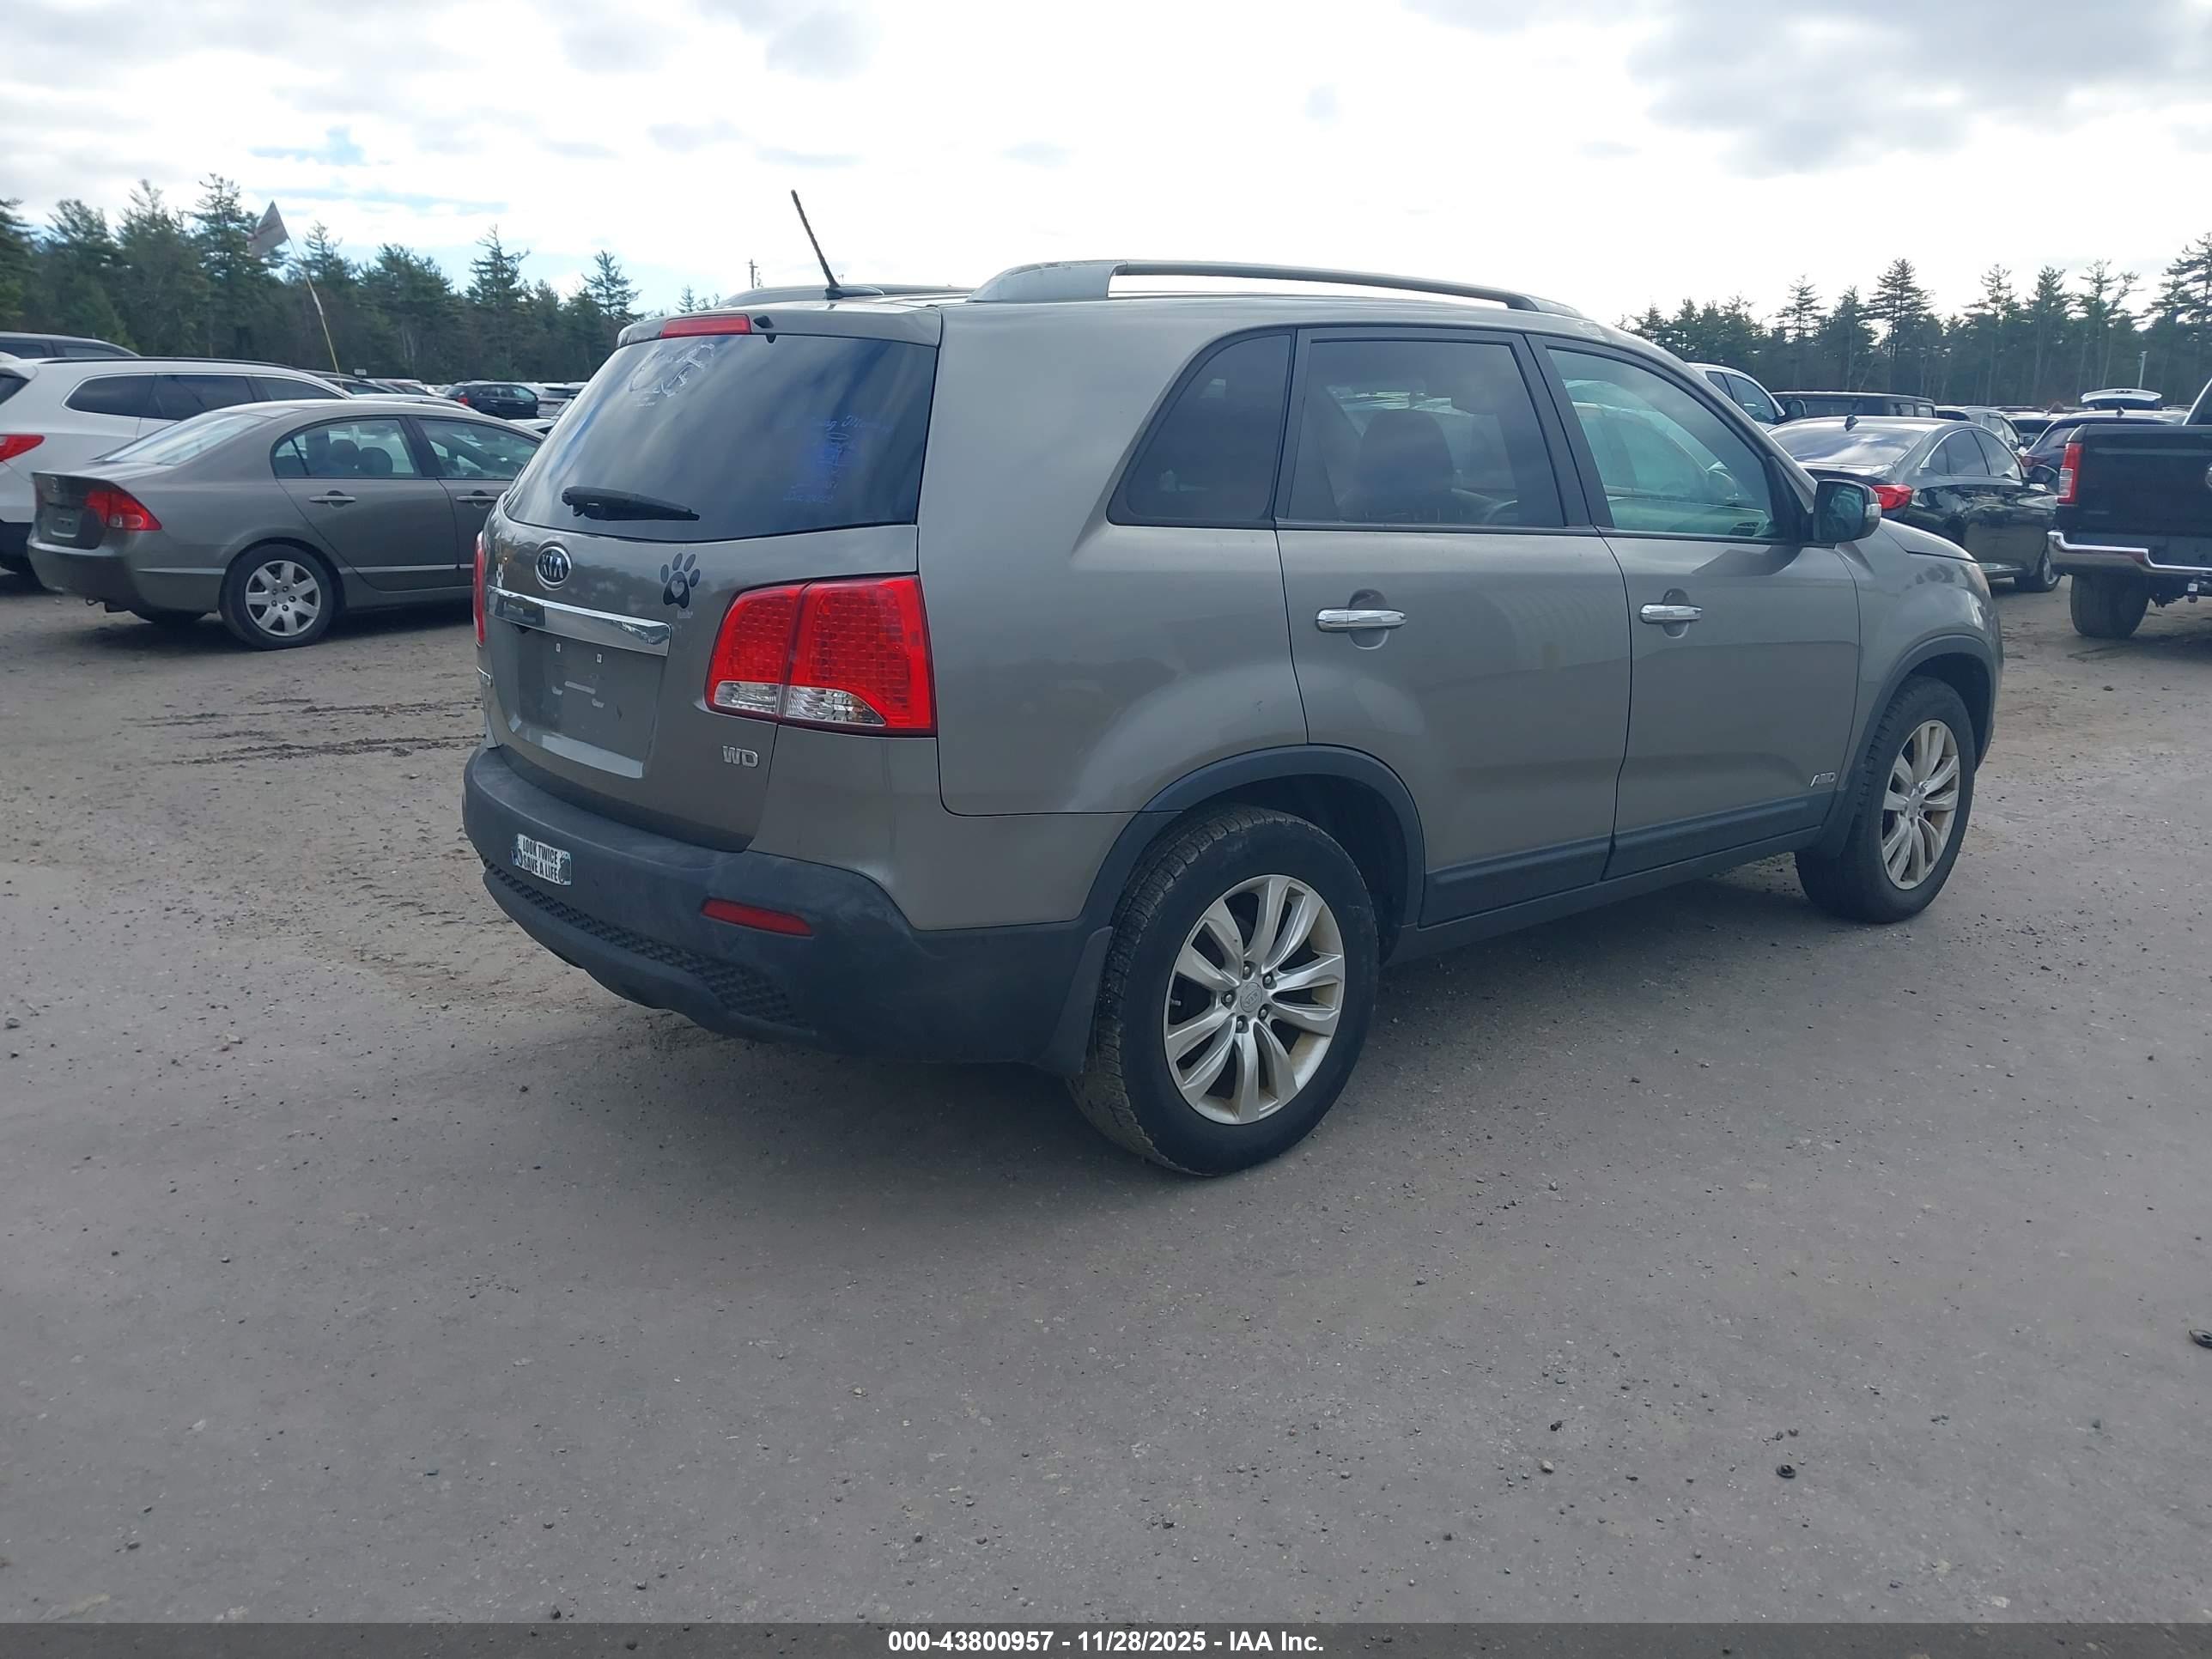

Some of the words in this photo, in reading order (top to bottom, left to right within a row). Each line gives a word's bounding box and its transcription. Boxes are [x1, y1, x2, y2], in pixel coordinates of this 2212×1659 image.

[542, 554, 563, 578] KIA
[522, 838, 538, 857] LOOK
[538, 845, 558, 864] TWICE
[523, 854, 538, 872] SAVE
[539, 861, 544, 876] A
[545, 863, 558, 882] LIFE
